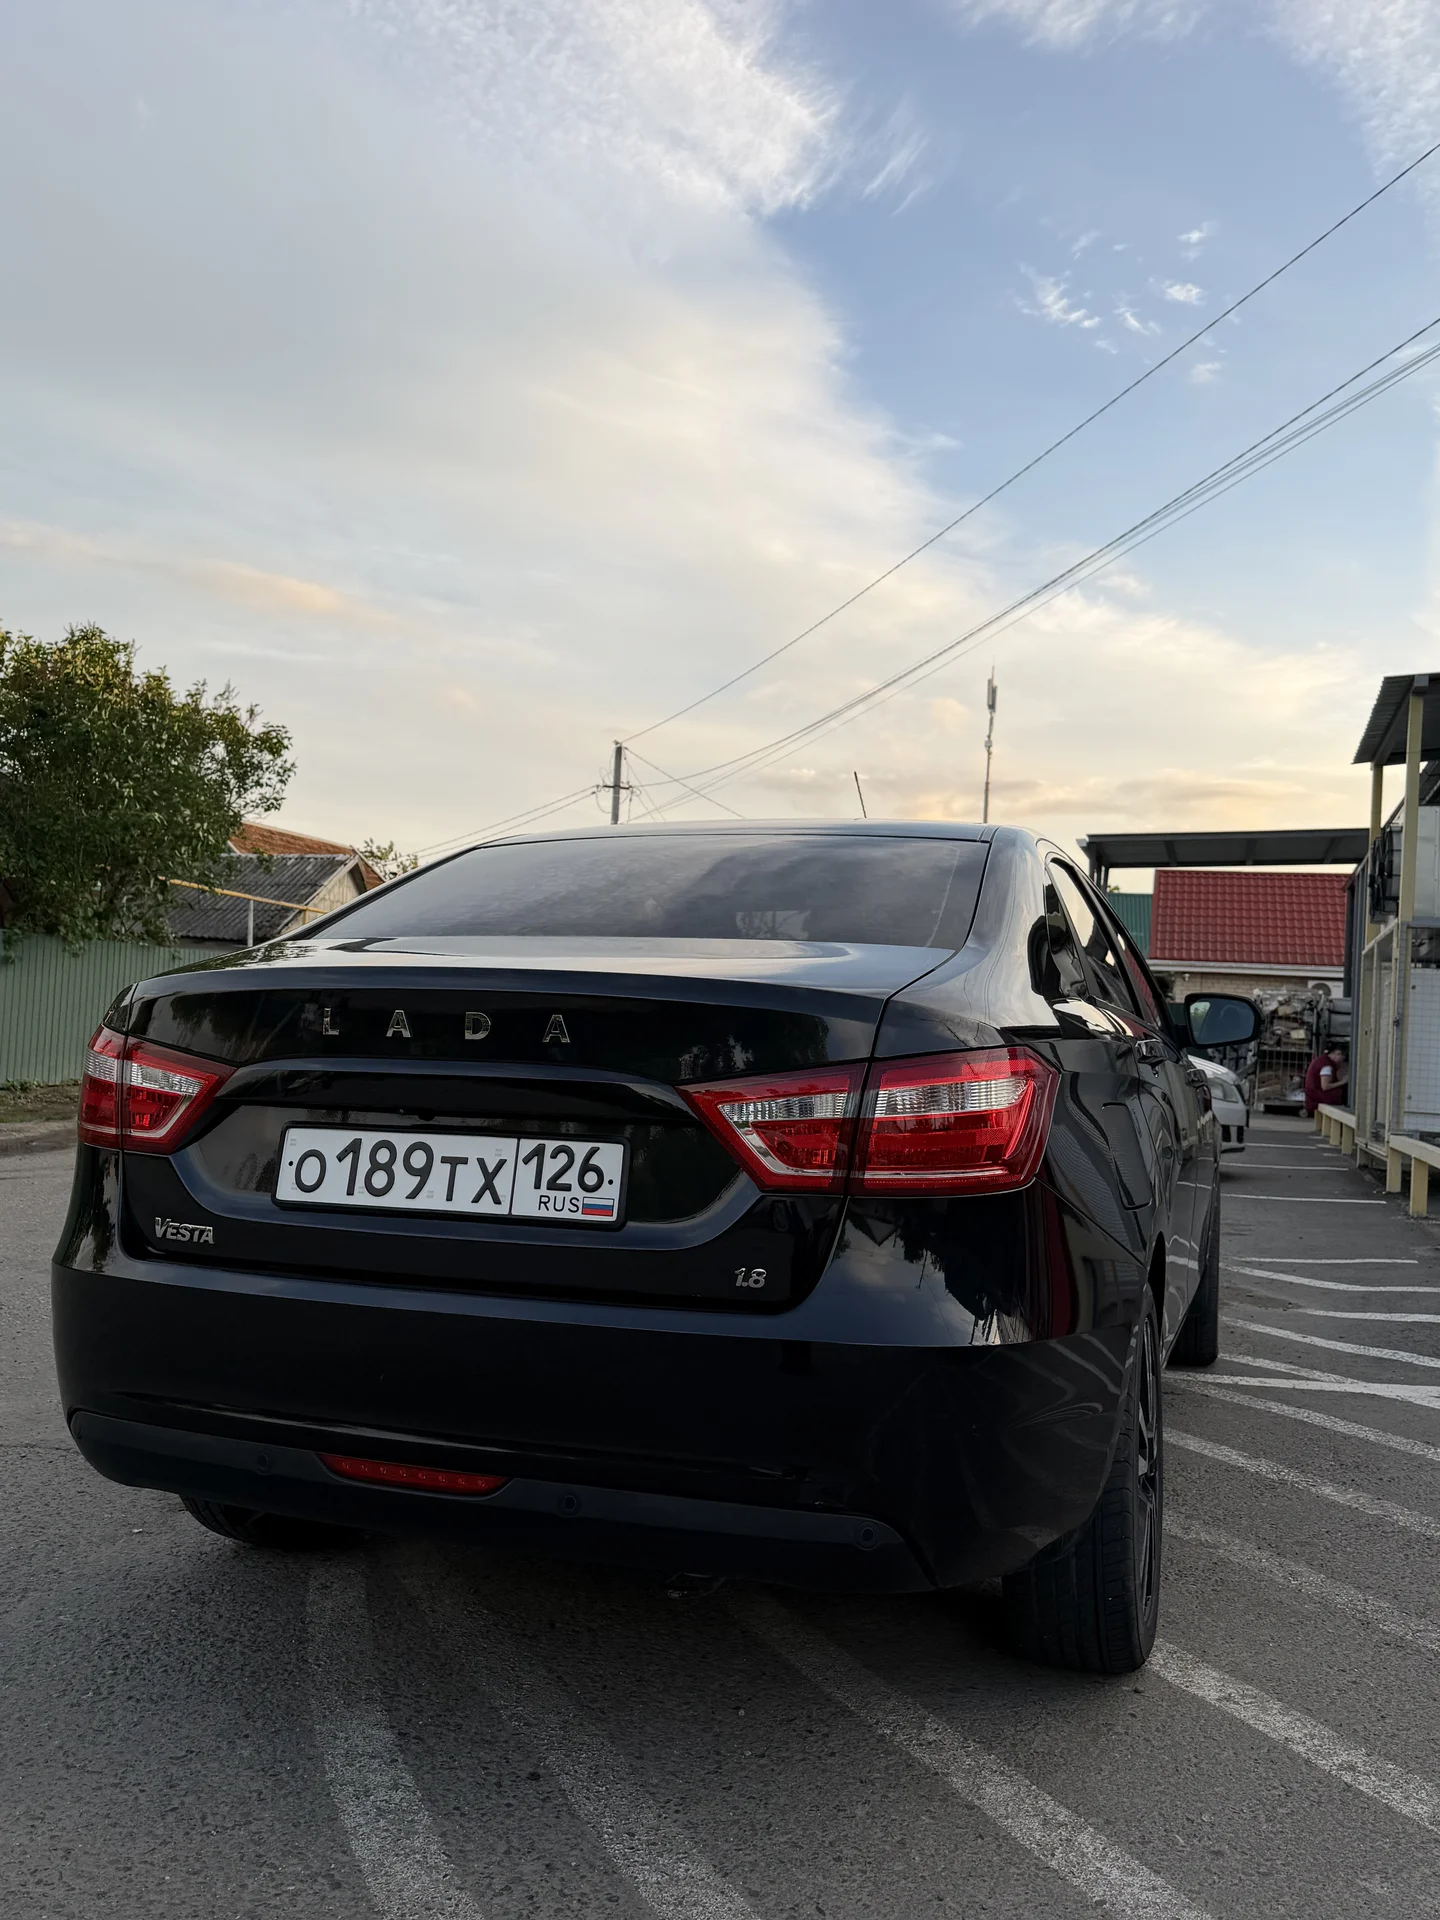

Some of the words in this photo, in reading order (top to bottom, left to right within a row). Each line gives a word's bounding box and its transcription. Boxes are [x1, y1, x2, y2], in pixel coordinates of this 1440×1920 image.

[322, 1007, 571, 1043] LADA
[521, 1142, 605, 1193] 126
[537, 1194, 580, 1214] RUS
[734, 1267, 767, 1289] 1.8
